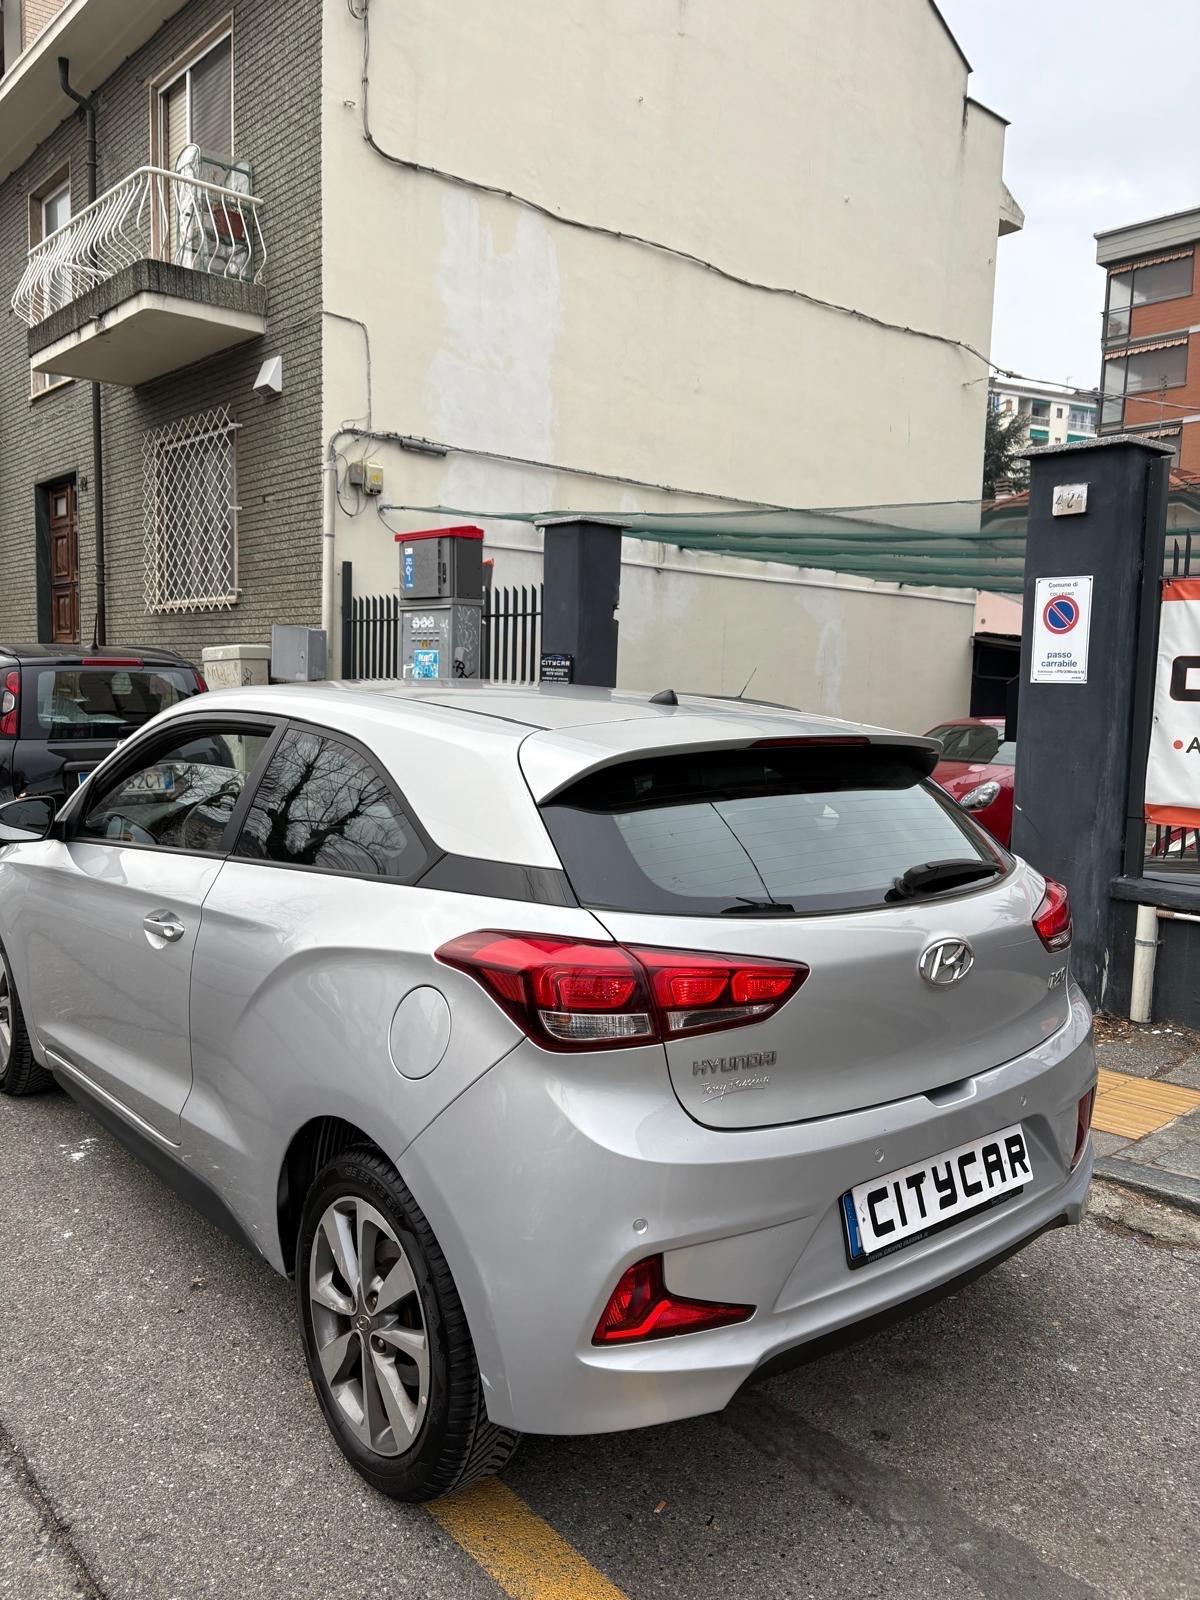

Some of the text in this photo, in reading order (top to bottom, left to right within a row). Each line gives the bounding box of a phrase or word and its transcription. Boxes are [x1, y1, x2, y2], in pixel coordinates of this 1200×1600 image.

[1046, 651, 1072, 660] passo
[541, 659, 570, 667] CITYCAR
[1040, 659, 1078, 668] carrabile
[692, 1050, 777, 1076] HYUNDAI
[866, 1133, 1030, 1238] CITYCAR
